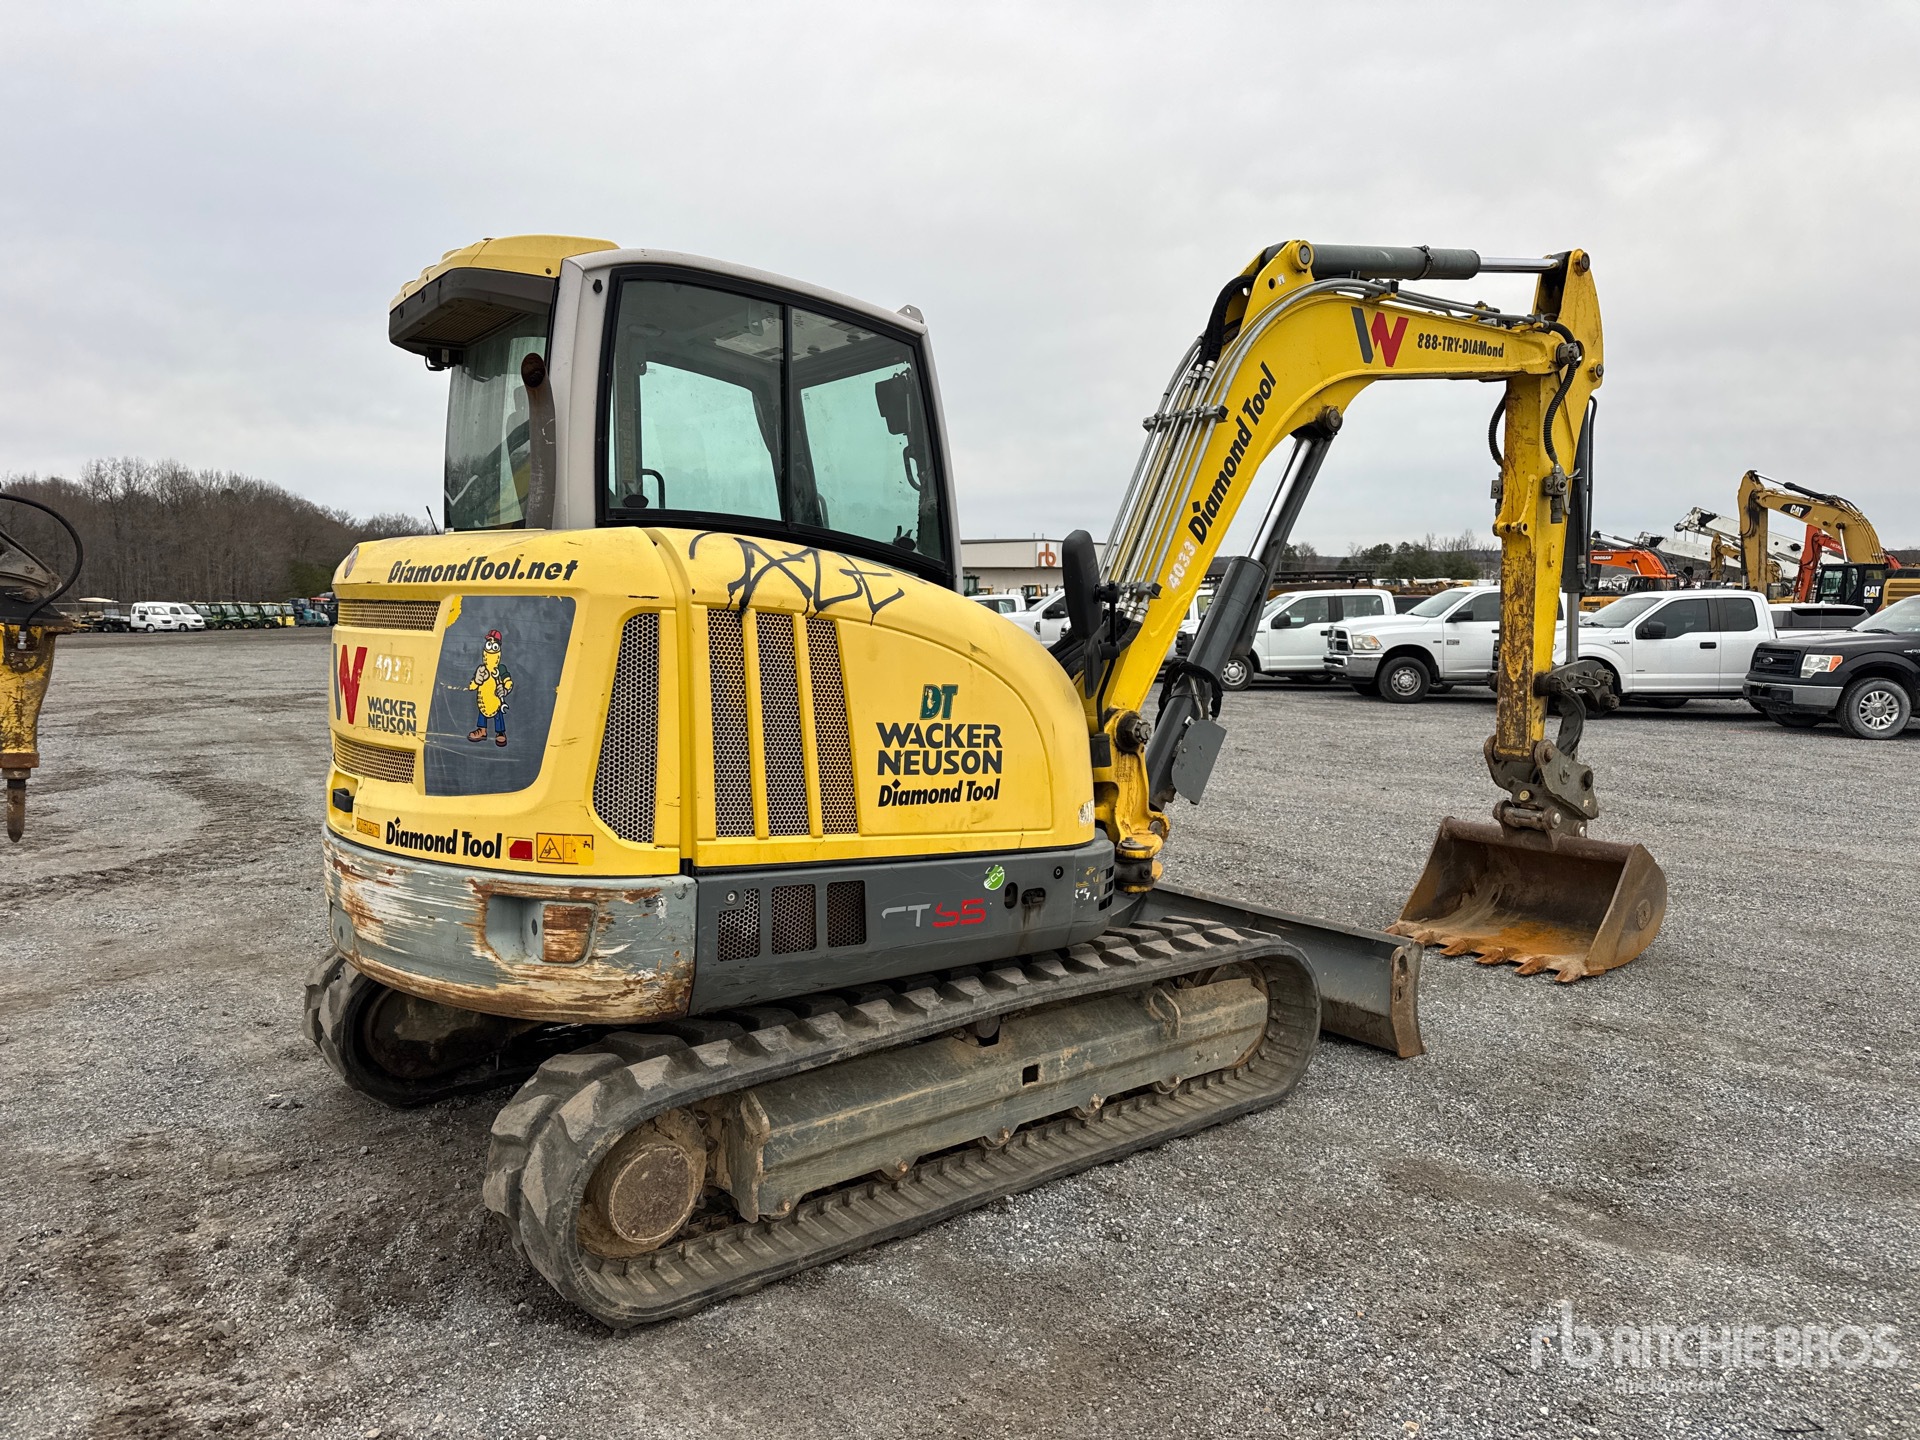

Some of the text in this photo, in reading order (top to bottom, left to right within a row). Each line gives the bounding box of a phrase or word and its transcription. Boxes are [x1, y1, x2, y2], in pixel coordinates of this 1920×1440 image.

[1417, 332, 1504, 358] 888-TRY-DIAMond
[1188, 361, 1277, 545] Diamond Tool
[1789, 504, 1804, 517] CAT
[1038, 543, 1057, 567] rb
[1169, 541, 1197, 589] 4033
[387, 554, 578, 584] DiamondTool.net
[1863, 585, 1881, 598] CAT
[367, 695, 417, 719] WACKER
[919, 684, 959, 720] DT
[367, 713, 417, 737] NEUSON
[876, 722, 1003, 749] WACKER
[877, 750, 1003, 775] NEUSON
[878, 778, 1001, 807] Diamond Tool
[386, 816, 458, 855] Diamond
[461, 831, 502, 859] Tool
